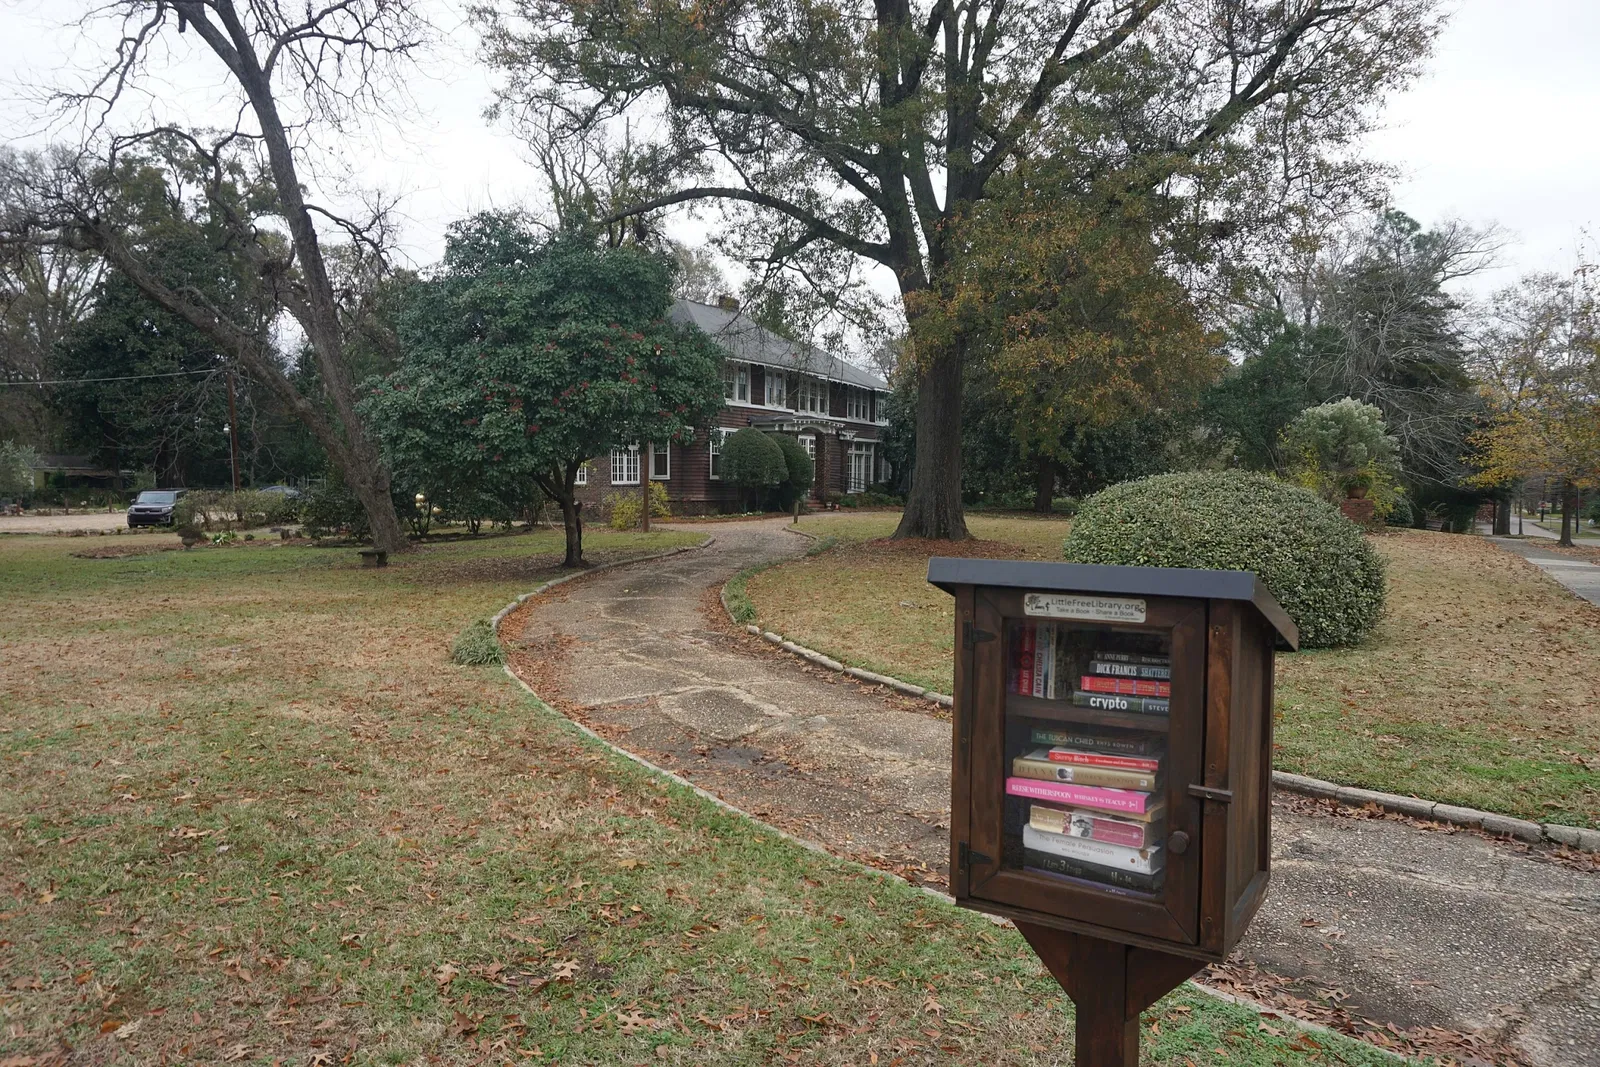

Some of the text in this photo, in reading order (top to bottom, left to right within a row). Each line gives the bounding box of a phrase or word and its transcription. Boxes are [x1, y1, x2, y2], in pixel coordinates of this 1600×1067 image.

[1051, 598, 1140, 612] LittleFreeLibrary.org
[1035, 652, 1043, 677] CHELSEA
[1096, 663, 1137, 676] DICK FRANCIS
[1141, 667, 1170, 679] SHATTERE
[1089, 697, 1128, 710] crypto
[1148, 704, 1169, 712] STEVE
[1036, 732, 1094, 746] THE TUSCAN CHILD
[1019, 764, 1054, 775] DIANA
[1011, 784, 1071, 799] REESE WITHERSPOON
[1052, 836, 1076, 848] Female
[1078, 841, 1115, 855] Persuasion
